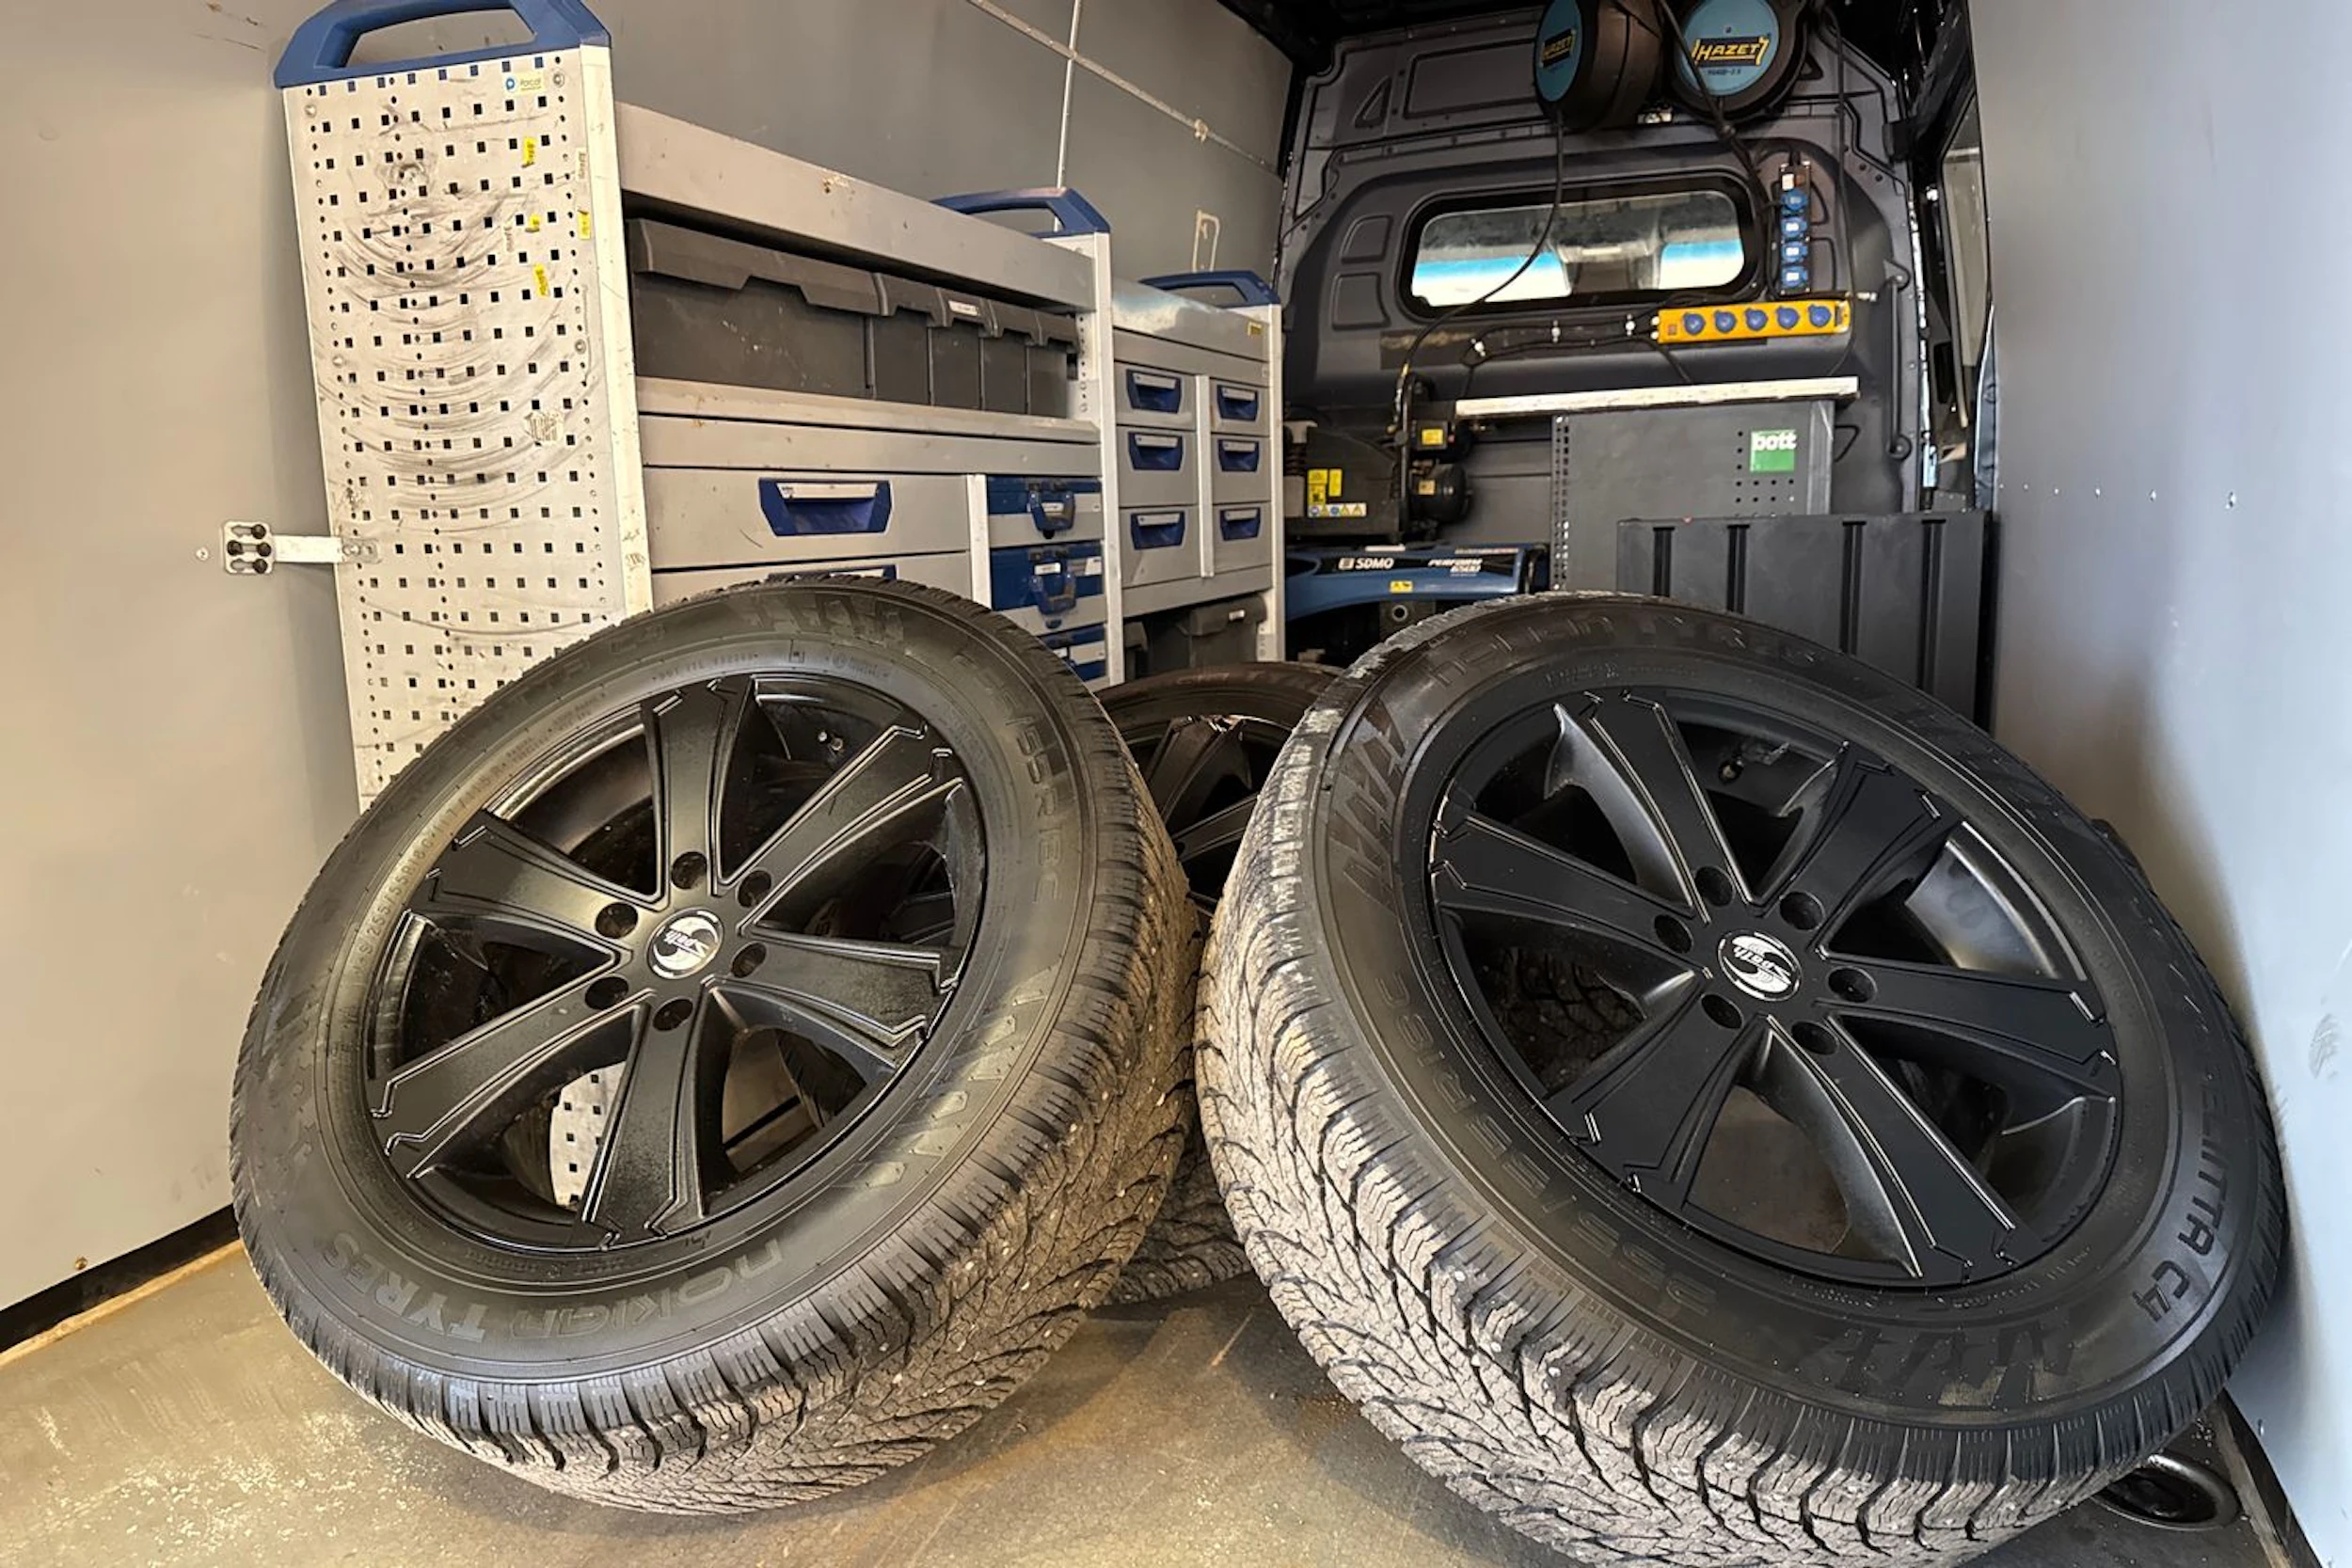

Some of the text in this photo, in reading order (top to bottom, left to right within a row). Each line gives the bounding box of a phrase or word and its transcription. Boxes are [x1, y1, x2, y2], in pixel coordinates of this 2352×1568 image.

[1693, 39, 1767, 63] HAZET
[324, 1233, 488, 1342] TYRES
[2132, 1260, 2190, 1323] C4
